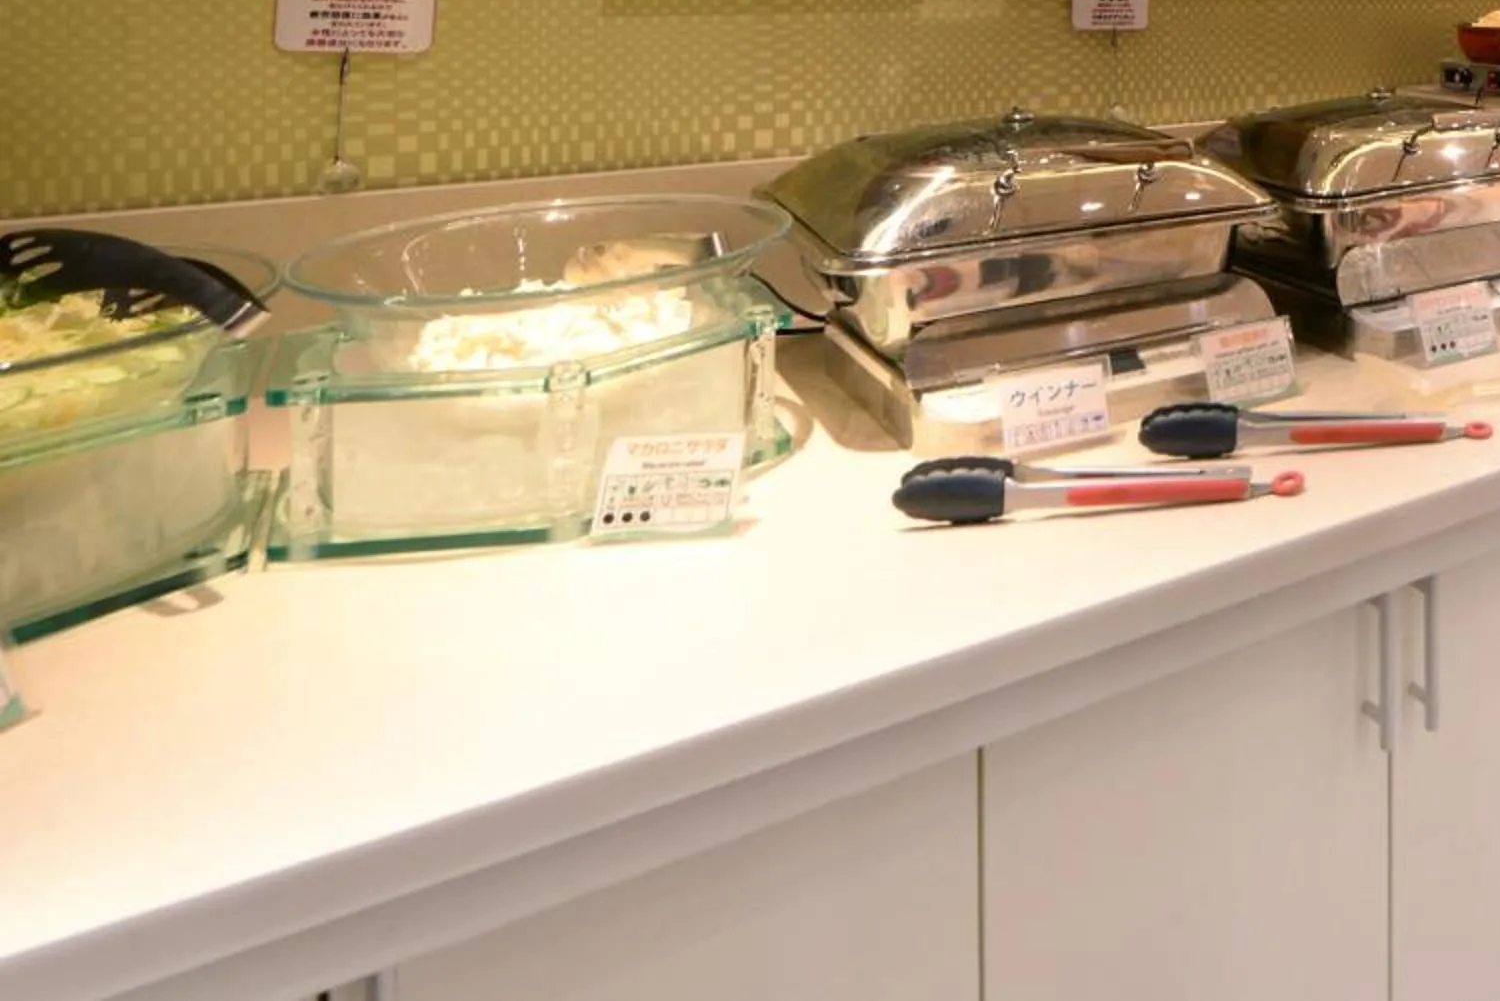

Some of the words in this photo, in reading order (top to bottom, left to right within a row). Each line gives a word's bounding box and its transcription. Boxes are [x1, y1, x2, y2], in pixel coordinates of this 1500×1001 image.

[1009, 380, 1096, 407] ウインナー
